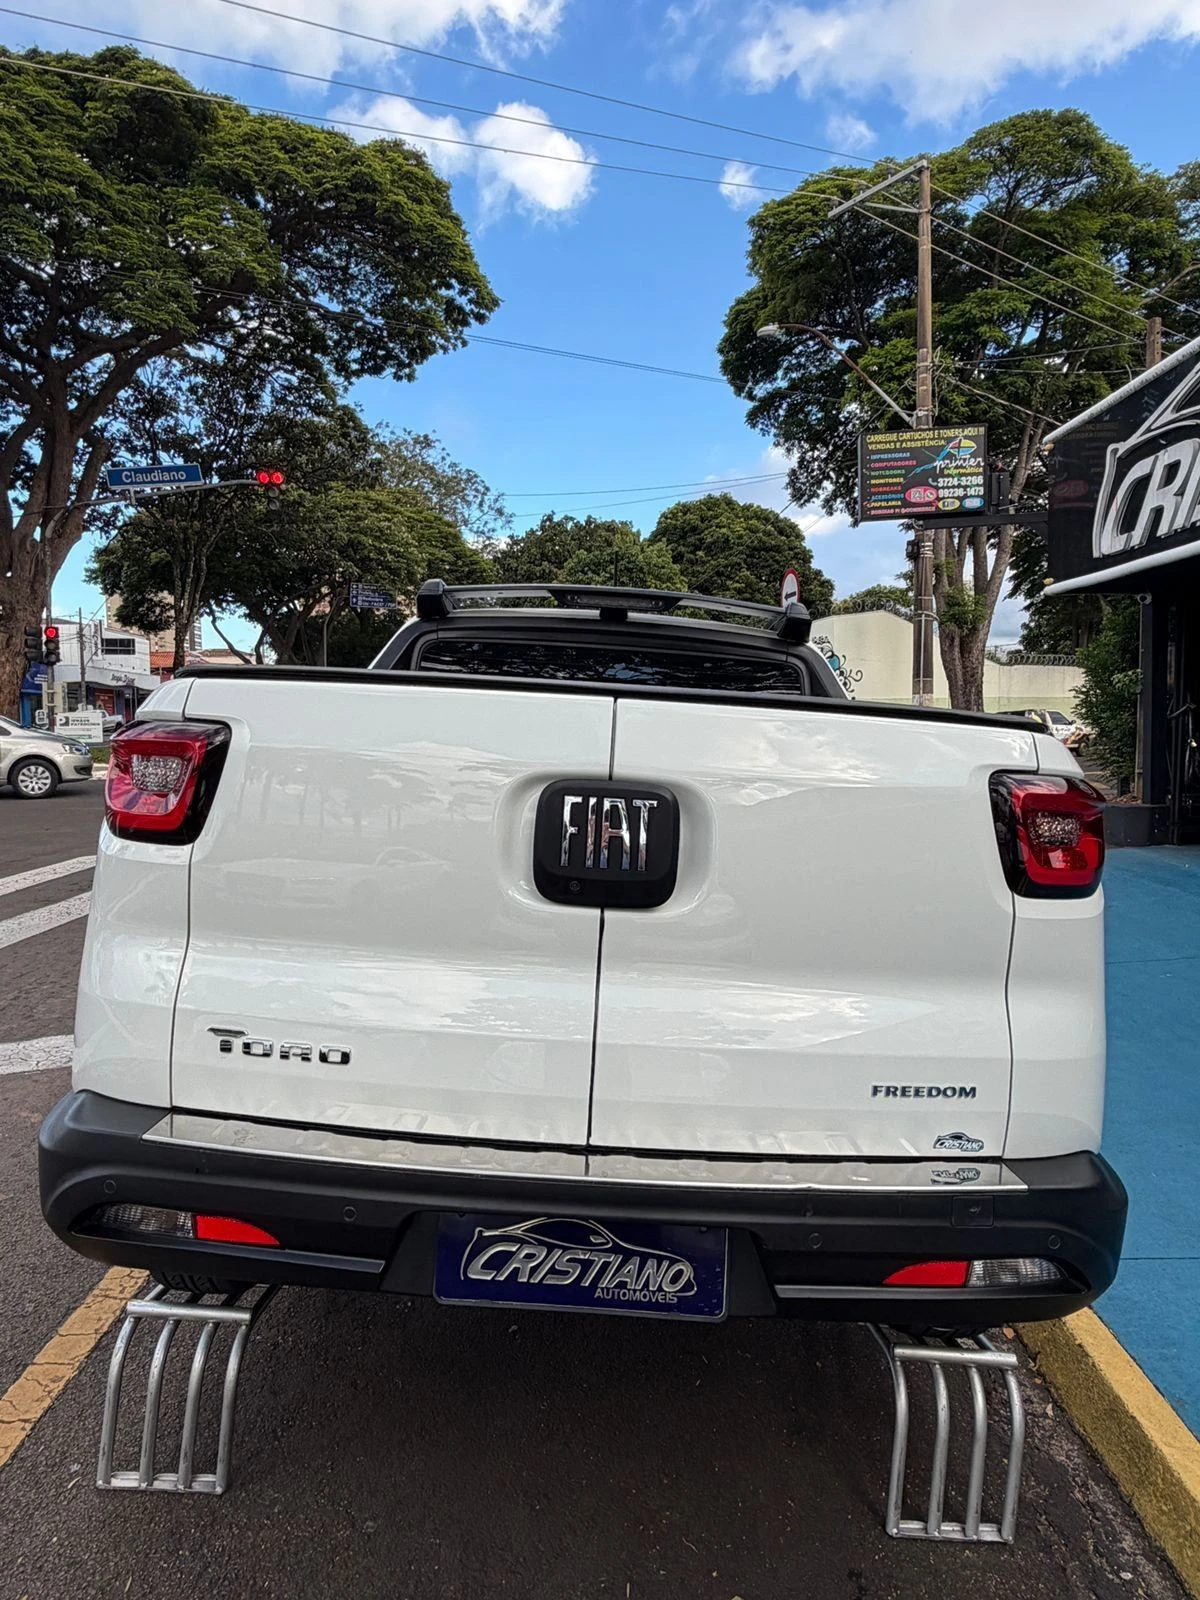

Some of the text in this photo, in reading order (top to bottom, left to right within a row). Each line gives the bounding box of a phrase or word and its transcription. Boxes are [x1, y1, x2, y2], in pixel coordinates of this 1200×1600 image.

[866, 432, 898, 443] CARREGUE
[898, 430, 933, 441] CARTUCHOS
[934, 429, 939, 438] E
[870, 452, 910, 460] IMPRESSORAS
[870, 460, 917, 468] COMPUTADORES
[121, 470, 187, 483] Claudiano
[870, 477, 904, 485] MONITORES
[937, 475, 984, 487] 3724-3266
[1100, 436, 1200, 556] CRI
[560, 795, 658, 871] FIAT
[206, 1025, 351, 1065] TORO
[871, 1085, 977, 1099] FREEDOM
[936, 1139, 983, 1151] CRISTIANO
[467, 1242, 692, 1293] CRISTIANO
[594, 1287, 678, 1304] AUTOMÓVEIS
